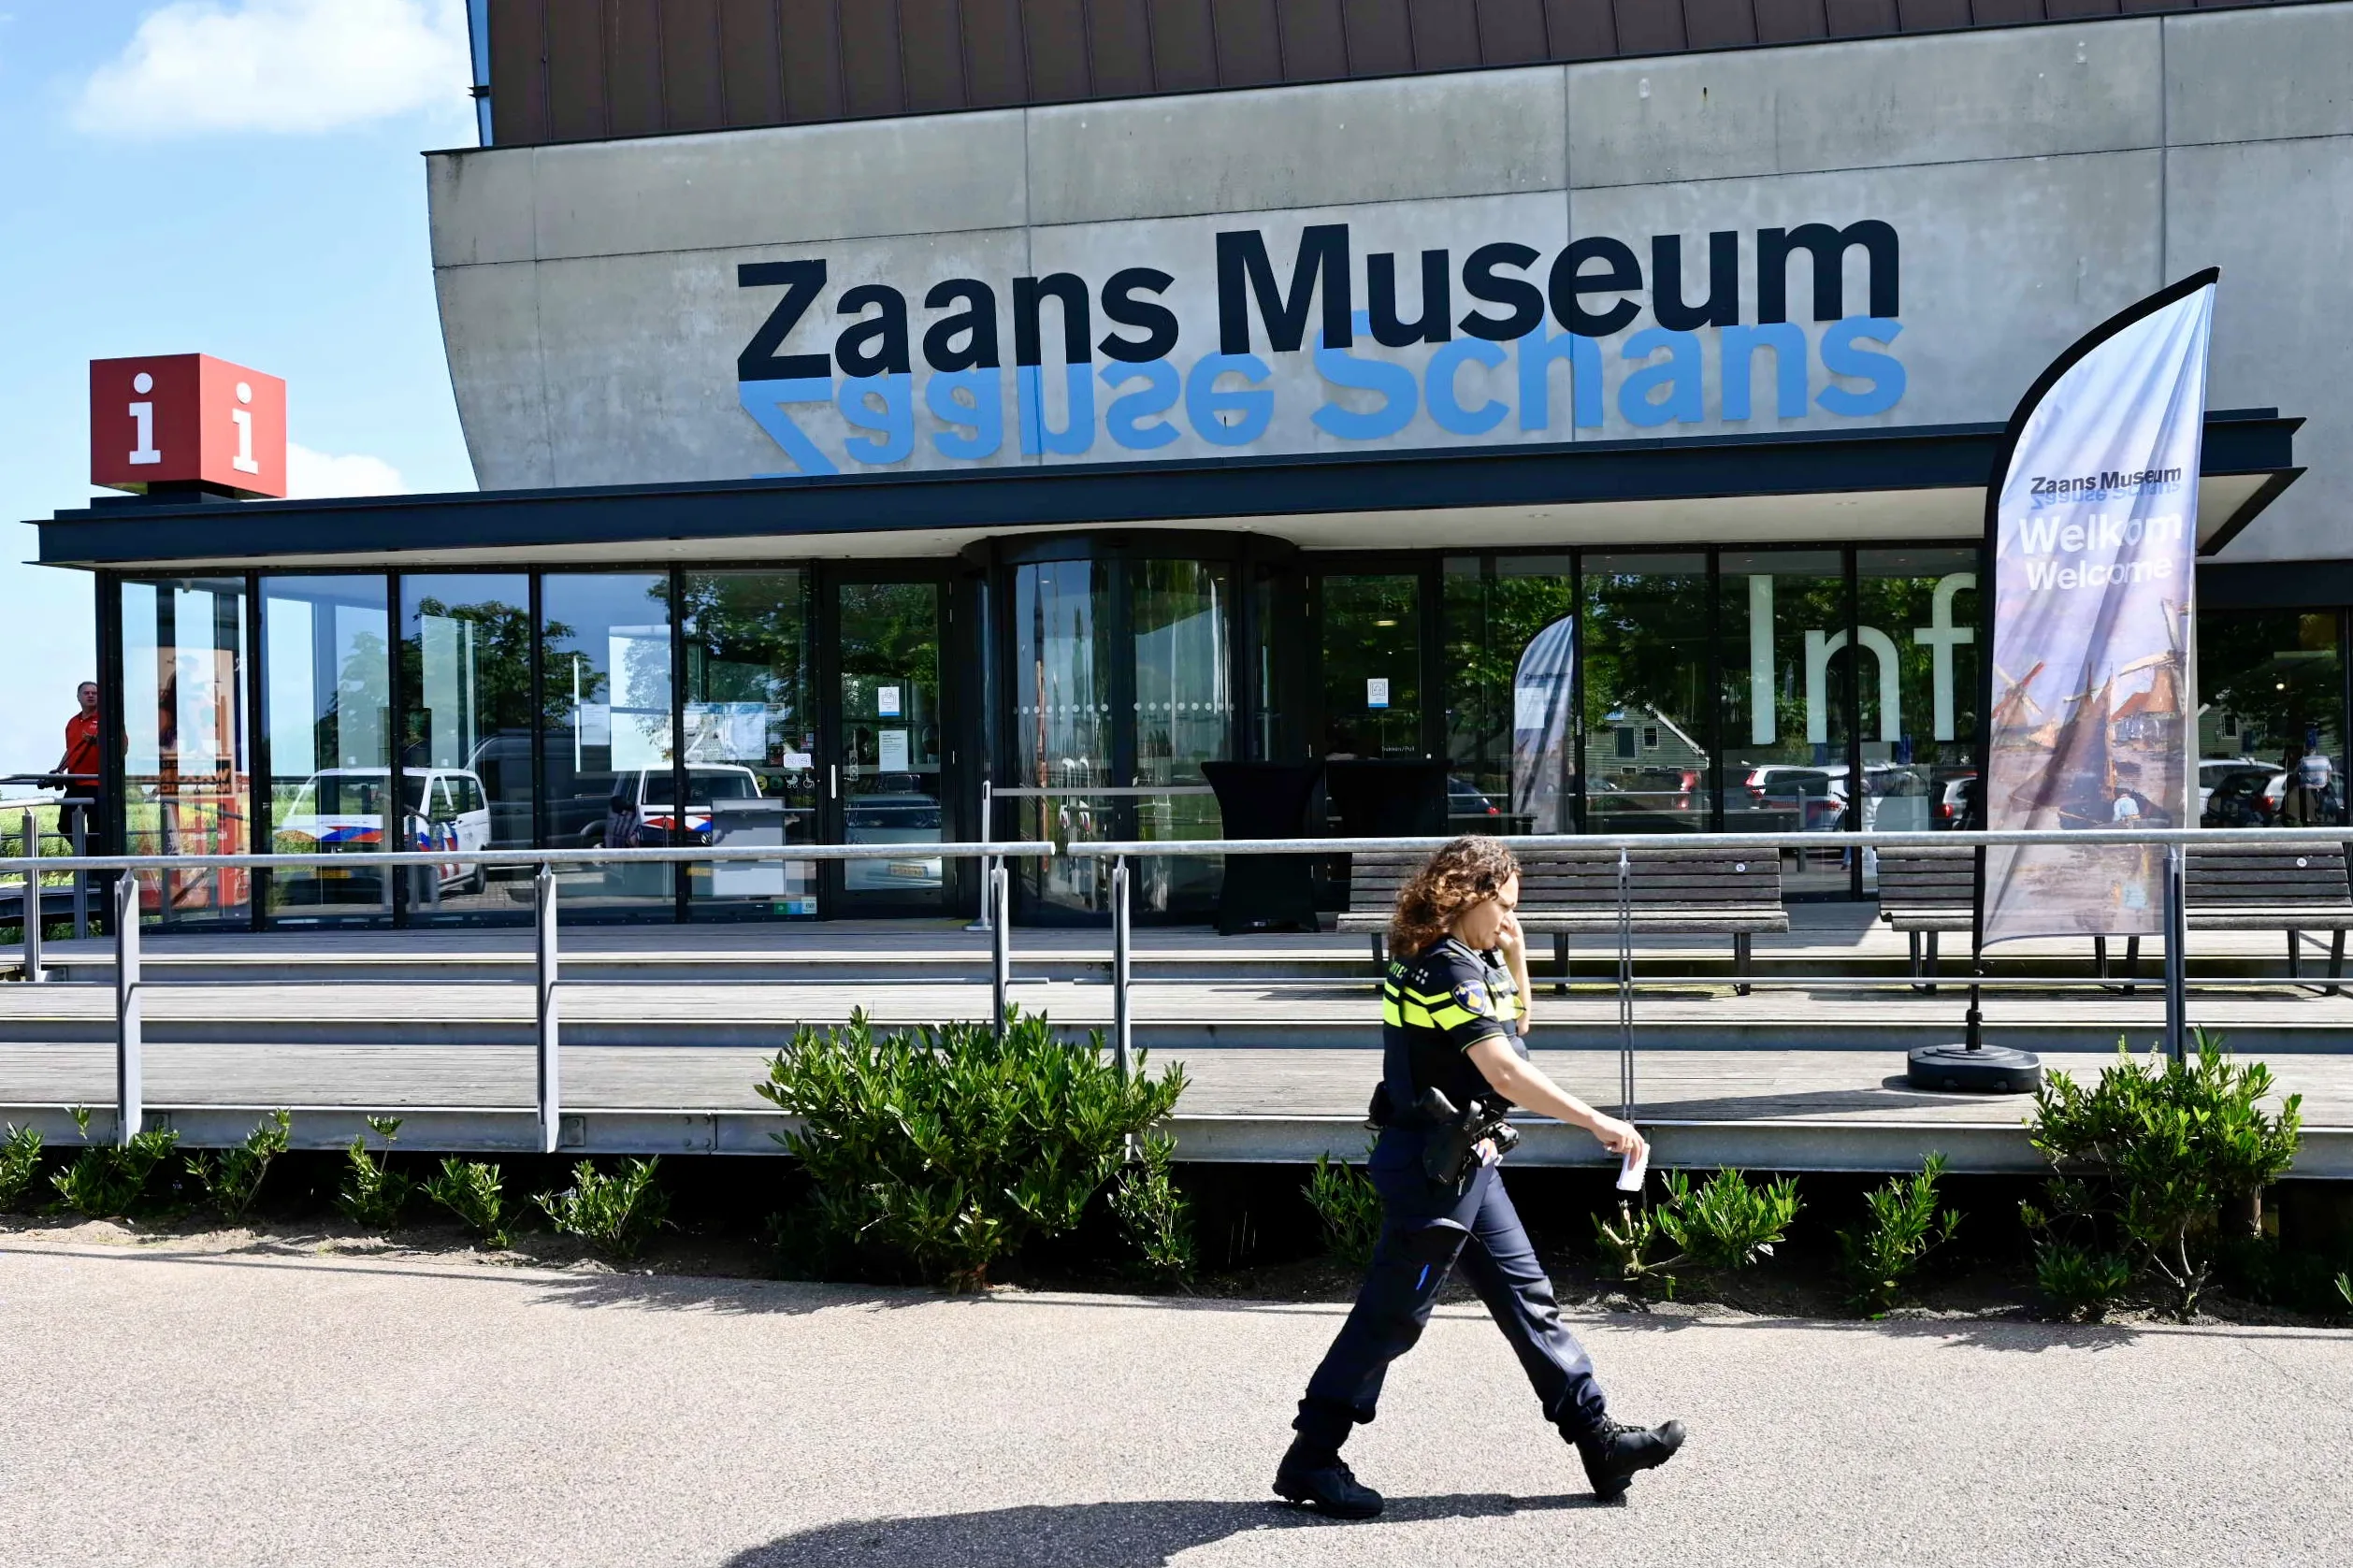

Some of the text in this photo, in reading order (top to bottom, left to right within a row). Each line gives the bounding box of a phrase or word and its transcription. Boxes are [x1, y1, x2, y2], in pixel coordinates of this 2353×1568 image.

[737, 219, 1899, 381] Zaans Museum
[1310, 309, 1906, 441] Schans
[2029, 467, 2182, 496] Zaans Museum
[2018, 512, 2183, 555] Welkom
[2026, 556, 2173, 591] Welcome
